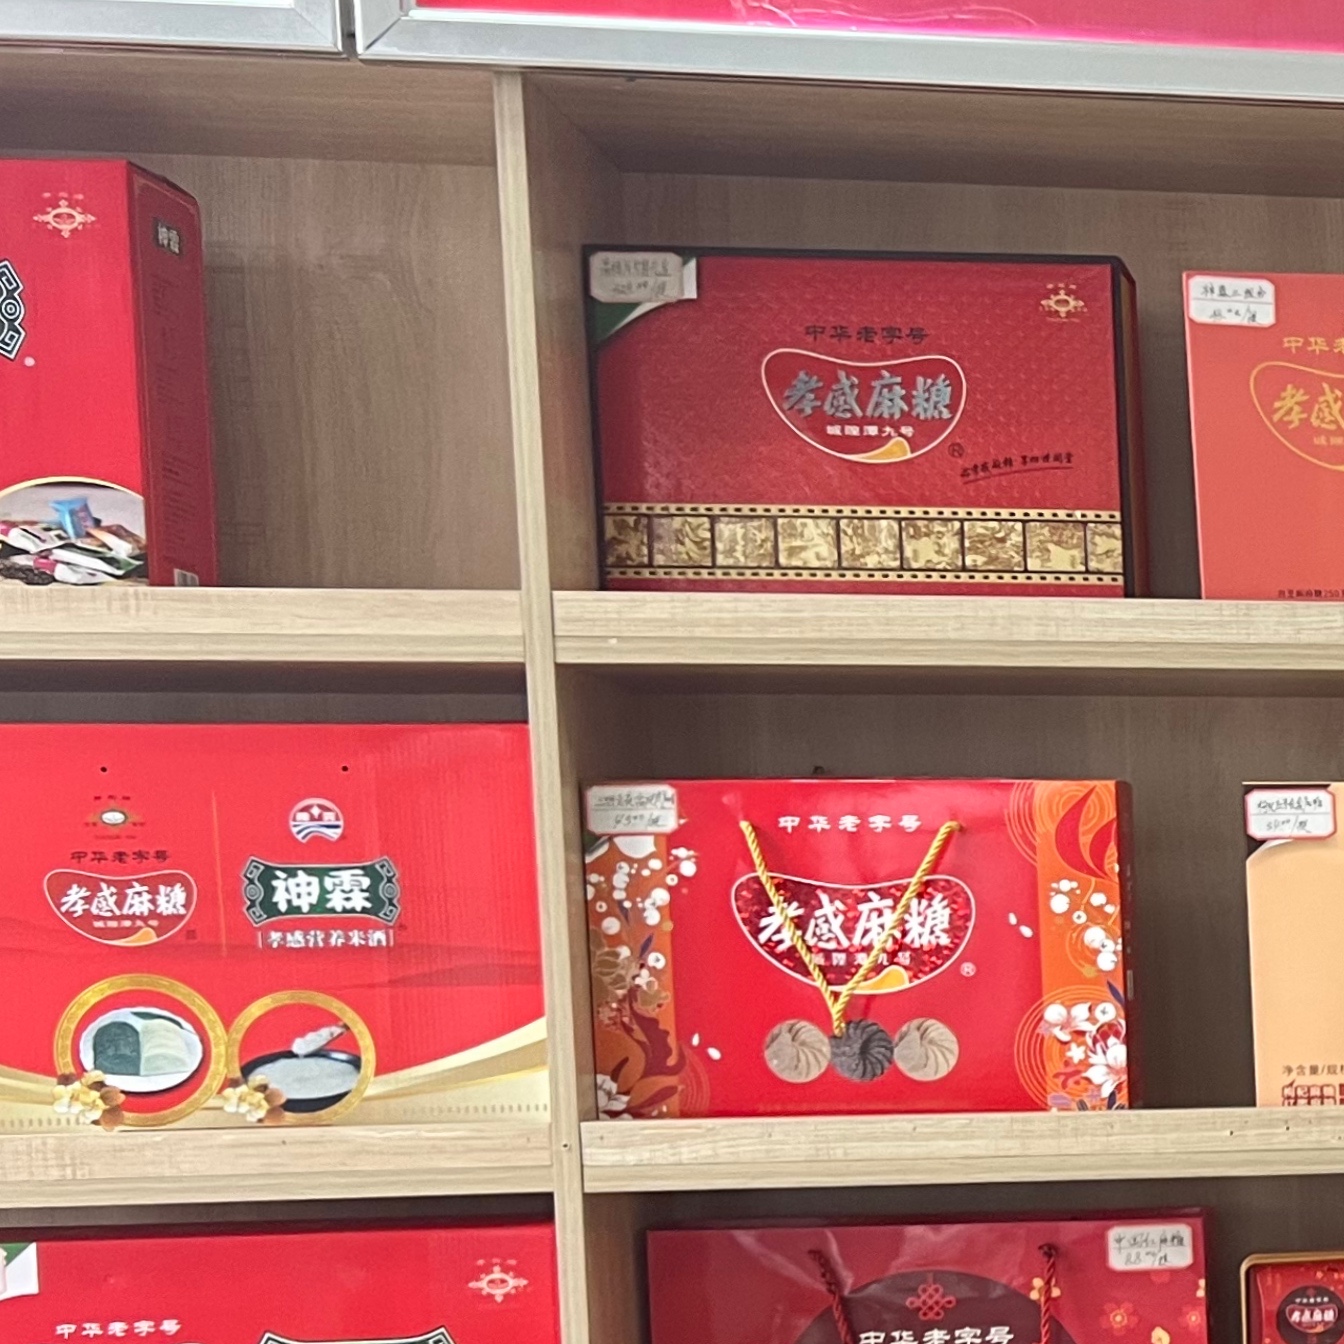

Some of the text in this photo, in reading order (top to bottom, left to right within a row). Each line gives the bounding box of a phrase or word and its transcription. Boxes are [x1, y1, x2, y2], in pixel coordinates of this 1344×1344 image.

[804, 324, 930, 345] 中华老字号
[782, 369, 953, 422] 孝感麻糖
[778, 814, 922, 833] 中华老字号
[60, 882, 188, 918] 孝感麻糖
[271, 870, 373, 915] 神霖
[759, 891, 952, 950] 孝感麻糖
[56, 1321, 182, 1340] 中华老字号
